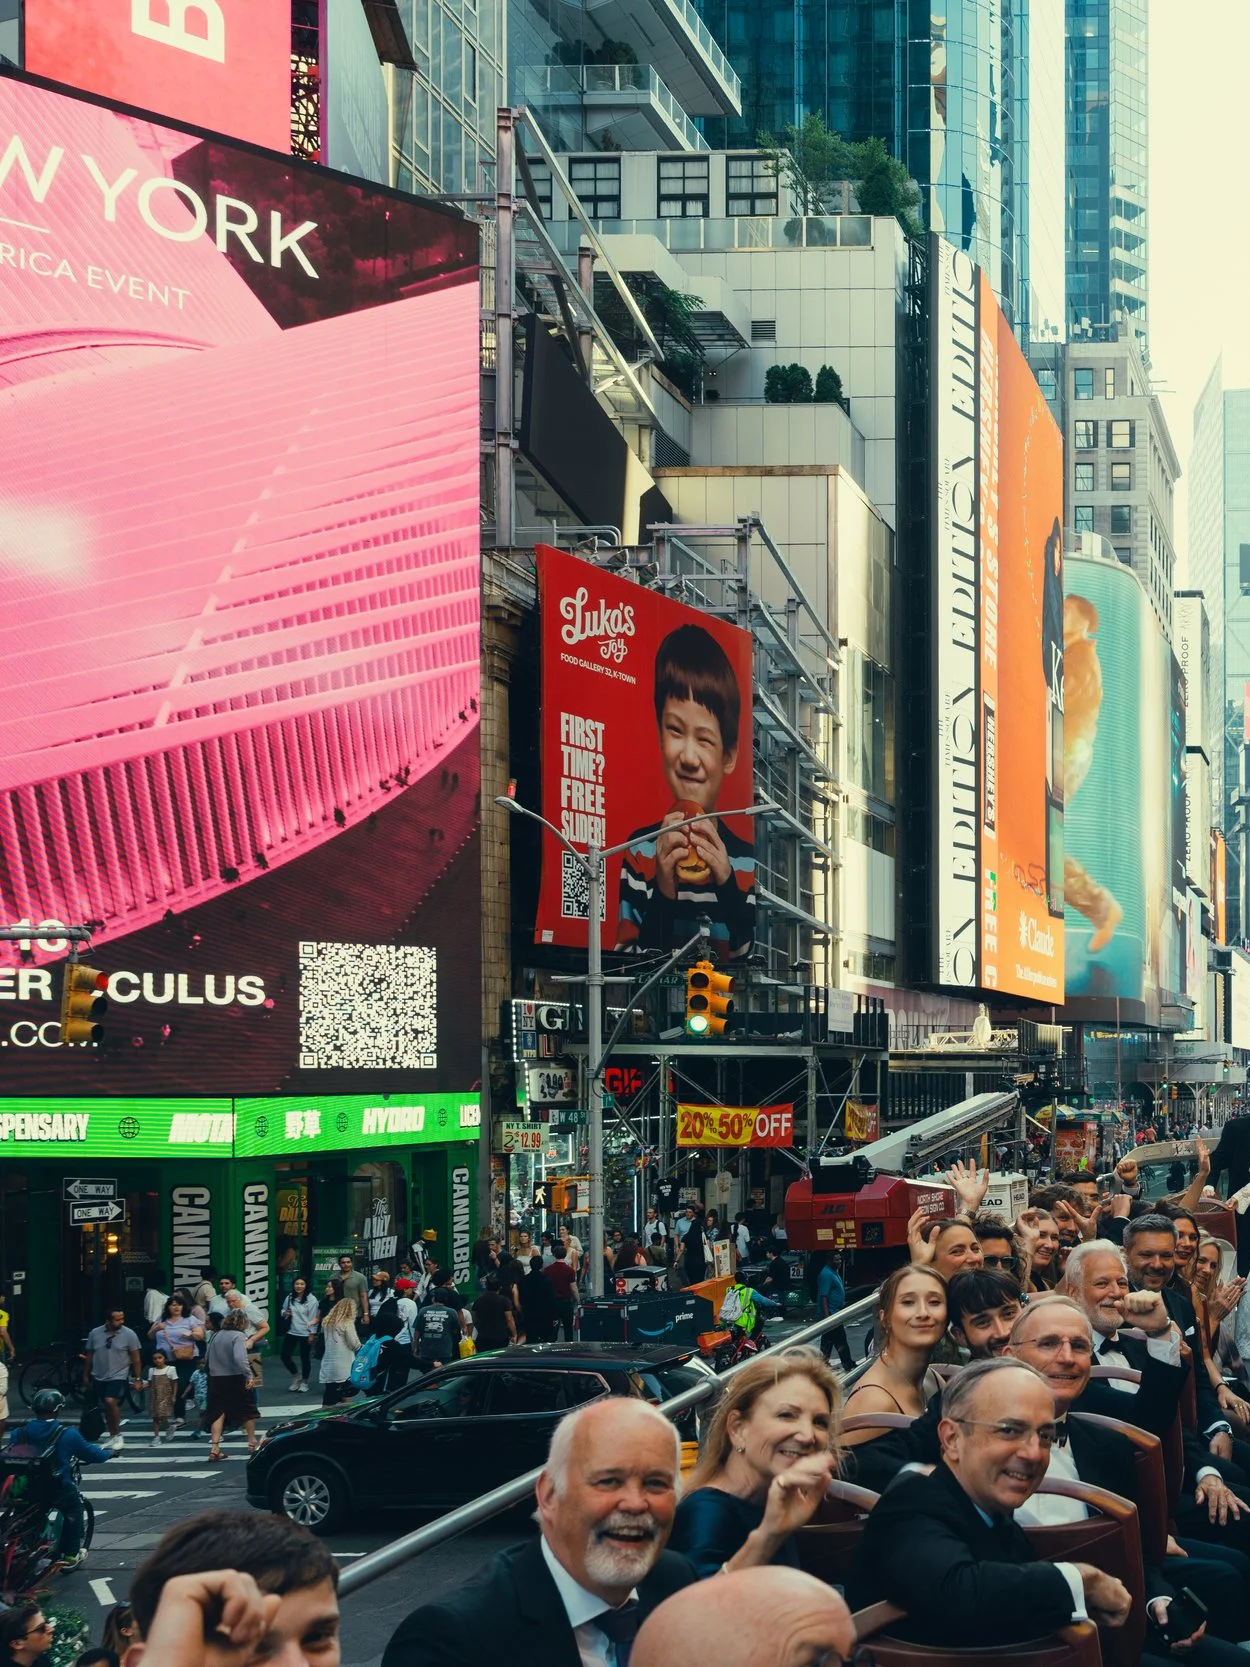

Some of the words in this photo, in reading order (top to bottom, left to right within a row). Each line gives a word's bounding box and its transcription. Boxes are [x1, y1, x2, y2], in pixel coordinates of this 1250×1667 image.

[81, 153, 319, 279] YORK
[87, 265, 191, 310] EVENT
[952, 450, 975, 653] EDITION
[560, 652, 578, 665] FOOD
[579, 659, 604, 674] GALLERY
[598, 639, 628, 663] Joy
[1181, 636, 1189, 674] PROOF
[560, 712, 605, 752] FIRST
[560, 744, 605, 783] TIME?
[560, 777, 605, 815] FREE
[952, 681, 975, 883] EDITION
[561, 809, 606, 847] SLIDER!
[984, 868, 997, 954] FREE
[1028, 917, 1054, 957] Claude
[91, 971, 266, 1006] CULUS
[0, 1113, 90, 1142] PENSARY
[362, 1106, 425, 1135] HYDRO
[506, 1122, 514, 1130] NY
[560, 1110, 566, 1120] W
[568, 1109, 579, 1120] 48
[680, 1111, 713, 1140] 20%
[718, 1112, 753, 1140] 50%
[755, 1113, 792, 1137] OFF
[73, 1185, 88, 1194] ONE
[95, 1185, 111, 1194] WAY
[917, 1193, 930, 1204] NORTH
[931, 1191, 944, 1202] SHORE
[980, 1198, 1003, 1206] EAD
[77, 1208, 92, 1218] ONE
[98, 1206, 114, 1216] WAY
[372, 1196, 388, 1220] The
[930, 1204, 939, 1213] SIGN
[452, 1167, 470, 1285] CANNABIS
[368, 1235, 398, 1261] GREEN
[675, 1312, 694, 1323] prime
[355, 1362, 364, 1372] 2
